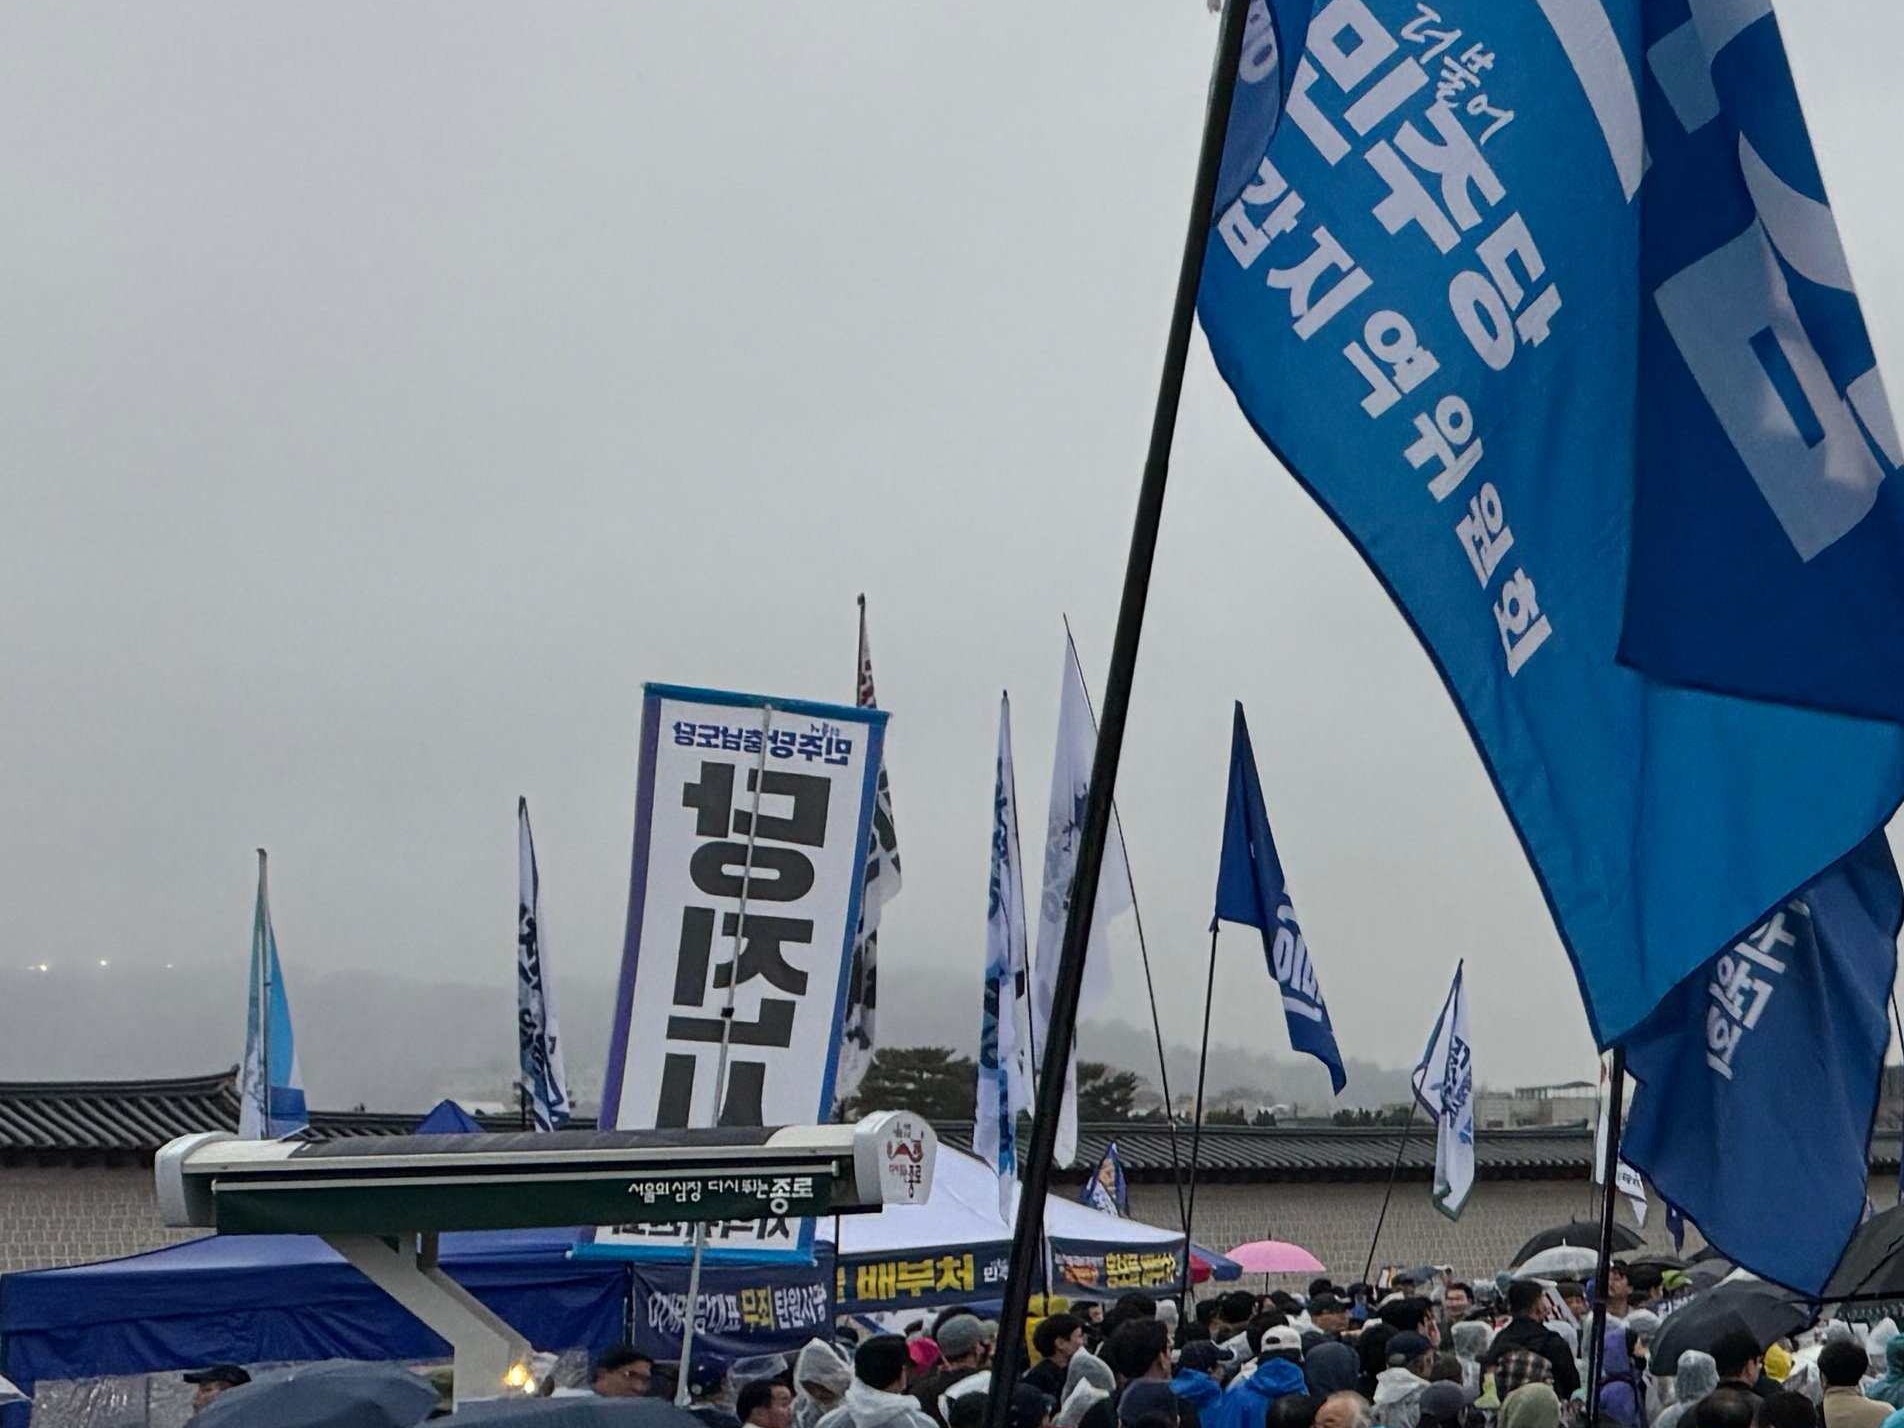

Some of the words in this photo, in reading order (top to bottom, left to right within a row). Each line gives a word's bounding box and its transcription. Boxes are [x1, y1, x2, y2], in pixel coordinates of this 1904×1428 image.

[1401, 2, 1515, 145] 더불어
[1220, 159, 1553, 677] 갑지역위원회
[628, 1182, 669, 1203] 서울의
[672, 1180, 702, 1202] 심장
[769, 1177, 814, 1214] 종로
[856, 1254, 976, 1302] 배부처
